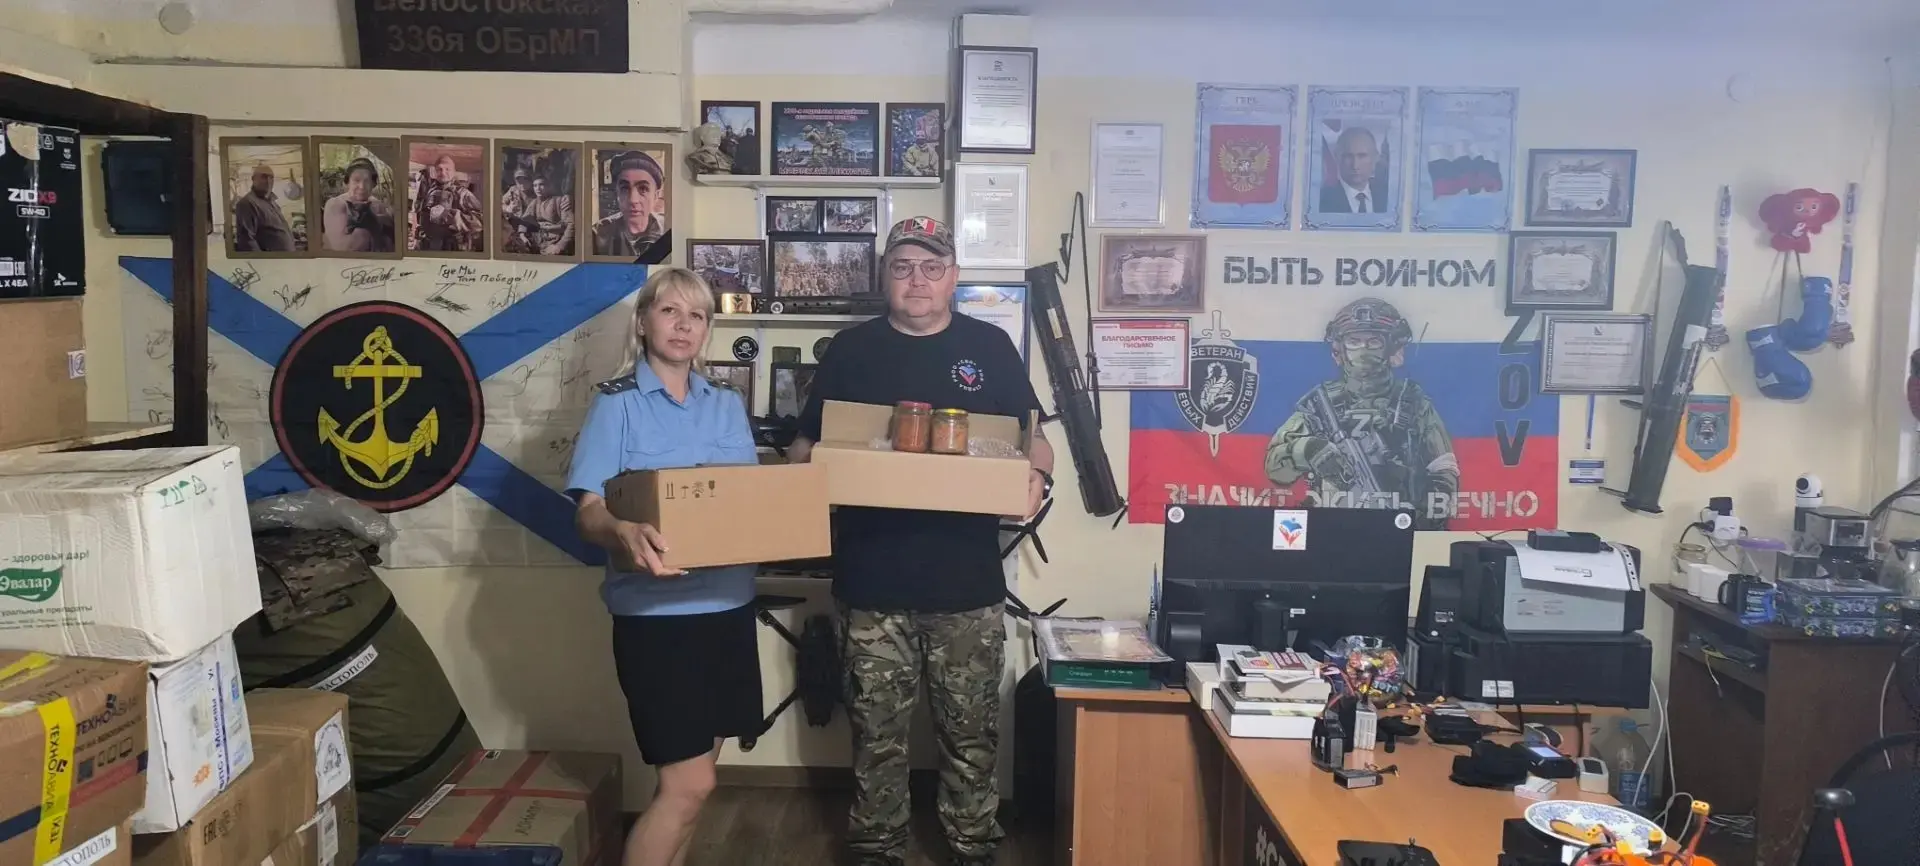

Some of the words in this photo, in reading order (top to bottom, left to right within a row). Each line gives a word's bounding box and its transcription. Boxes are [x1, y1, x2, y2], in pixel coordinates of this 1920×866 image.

[388, 25, 464, 52] 336я
[476, 26, 600, 60] ОБрМП
[458, 265, 476, 275] Мы
[1223, 256, 1325, 286] БЫТЬ
[1335, 258, 1497, 288] ВОИНОМ
[1191, 346, 1242, 359] ВЕТЕРАН
[1178, 391, 1202, 424] ЕВЫХ
[1164, 483, 1293, 506] ЗНАЧИТ
[1305, 490, 1415, 509] ЖИТЬ
[1427, 491, 1540, 520] ВЕЧНО
[0, 575, 52, 591] Эвалар
[0, 608, 43, 617] уральные
[319, 652, 374, 691] АСТОПОЛЬ
[45, 722, 60, 812] ТЕХНОАВИА
[56, 835, 111, 866] ТОПОЛЬ
